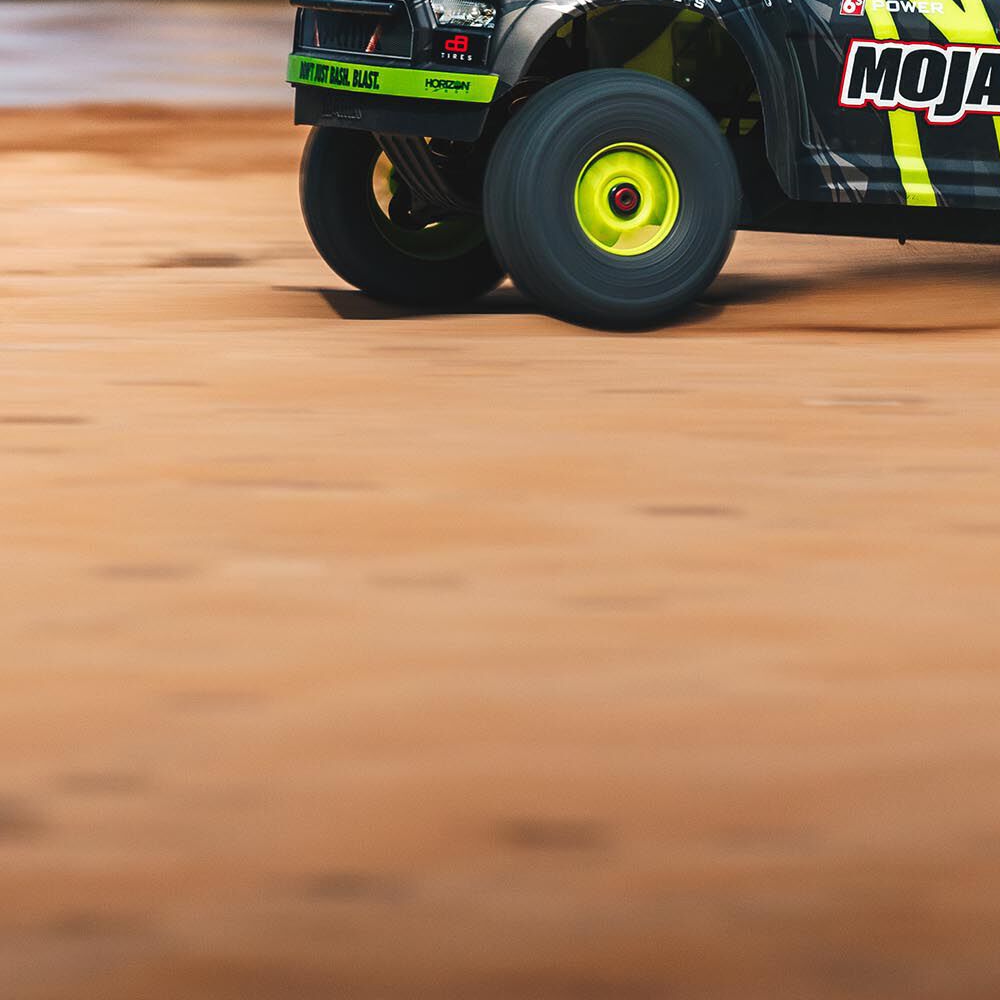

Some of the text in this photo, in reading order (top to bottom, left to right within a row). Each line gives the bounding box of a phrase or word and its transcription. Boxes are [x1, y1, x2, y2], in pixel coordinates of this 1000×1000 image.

[871, 0, 944, 14] POWER
[441, 52, 473, 61] TIRES
[330, 65, 351, 87] BASH.
[352, 68, 380, 90] BLAST.
[425, 78, 471, 90] HORIZON
